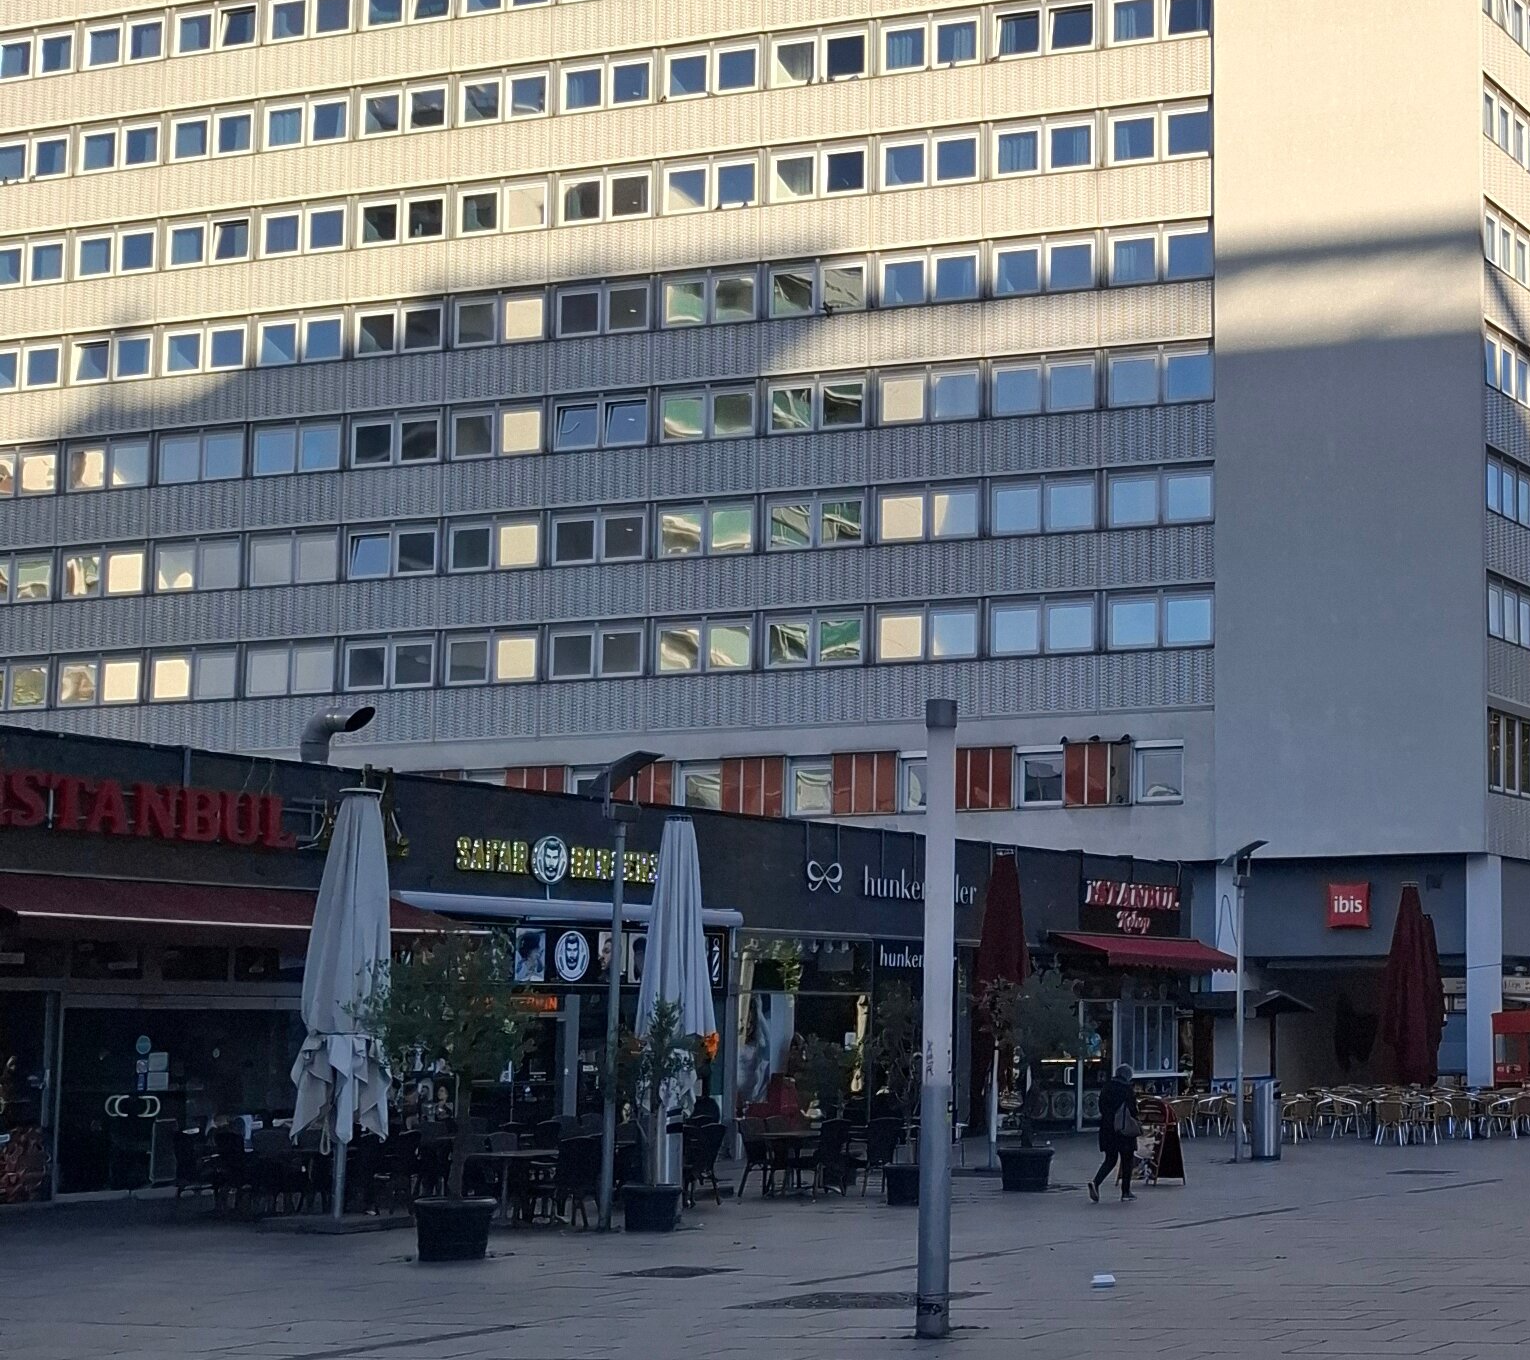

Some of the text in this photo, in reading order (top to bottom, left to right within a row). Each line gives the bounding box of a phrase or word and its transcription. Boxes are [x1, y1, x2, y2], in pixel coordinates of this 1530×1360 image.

[0, 768, 297, 849] STANBUL
[456, 836, 529, 874] SAFAR
[864, 865, 977, 905] hunkeler
[1333, 895, 1363, 913] ibis
